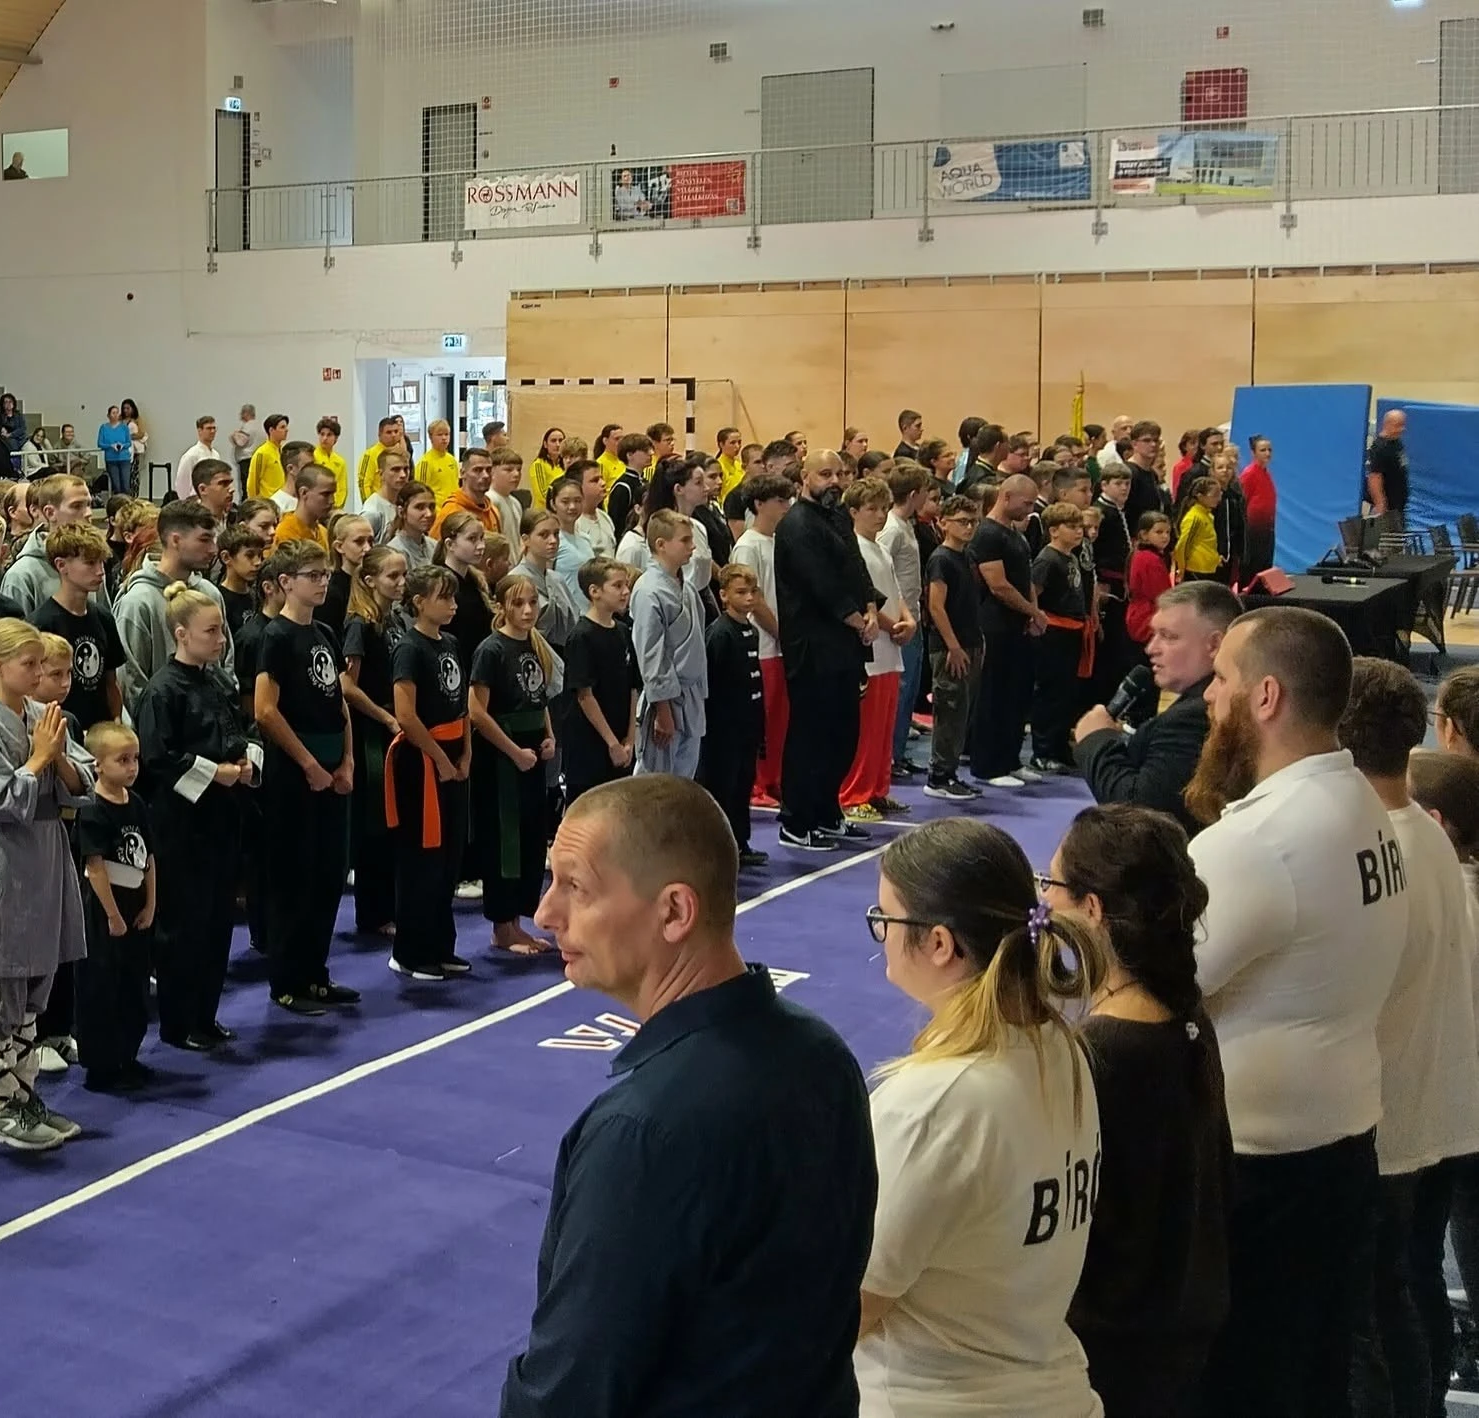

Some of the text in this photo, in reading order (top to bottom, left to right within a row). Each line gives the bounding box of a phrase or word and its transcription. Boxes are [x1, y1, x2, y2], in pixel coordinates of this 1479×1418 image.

[940, 162, 984, 183] AQUA
[467, 180, 578, 205] ROSSMANN
[938, 173, 993, 198] WORLD
[1356, 829, 1407, 906] BÍR
